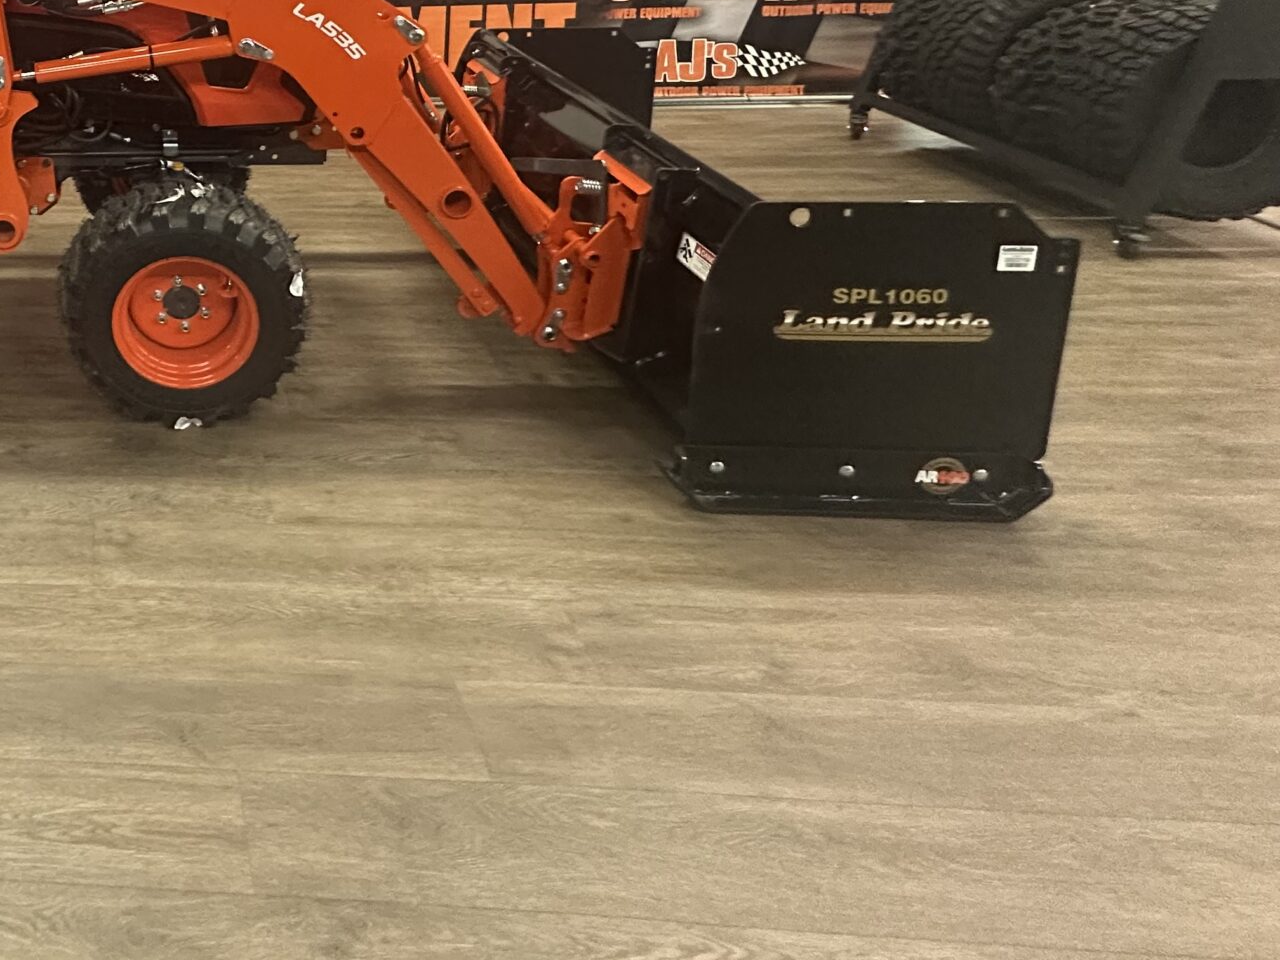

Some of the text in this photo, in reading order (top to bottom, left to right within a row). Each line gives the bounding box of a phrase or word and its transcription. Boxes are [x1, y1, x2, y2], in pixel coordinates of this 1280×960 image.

[640, 6, 703, 21] EQUIPMENT
[292, 2, 367, 60] LA535
[654, 38, 738, 82] AJ'S
[832, 288, 949, 305] SPL1060
[781, 309, 990, 332] Land Pride
